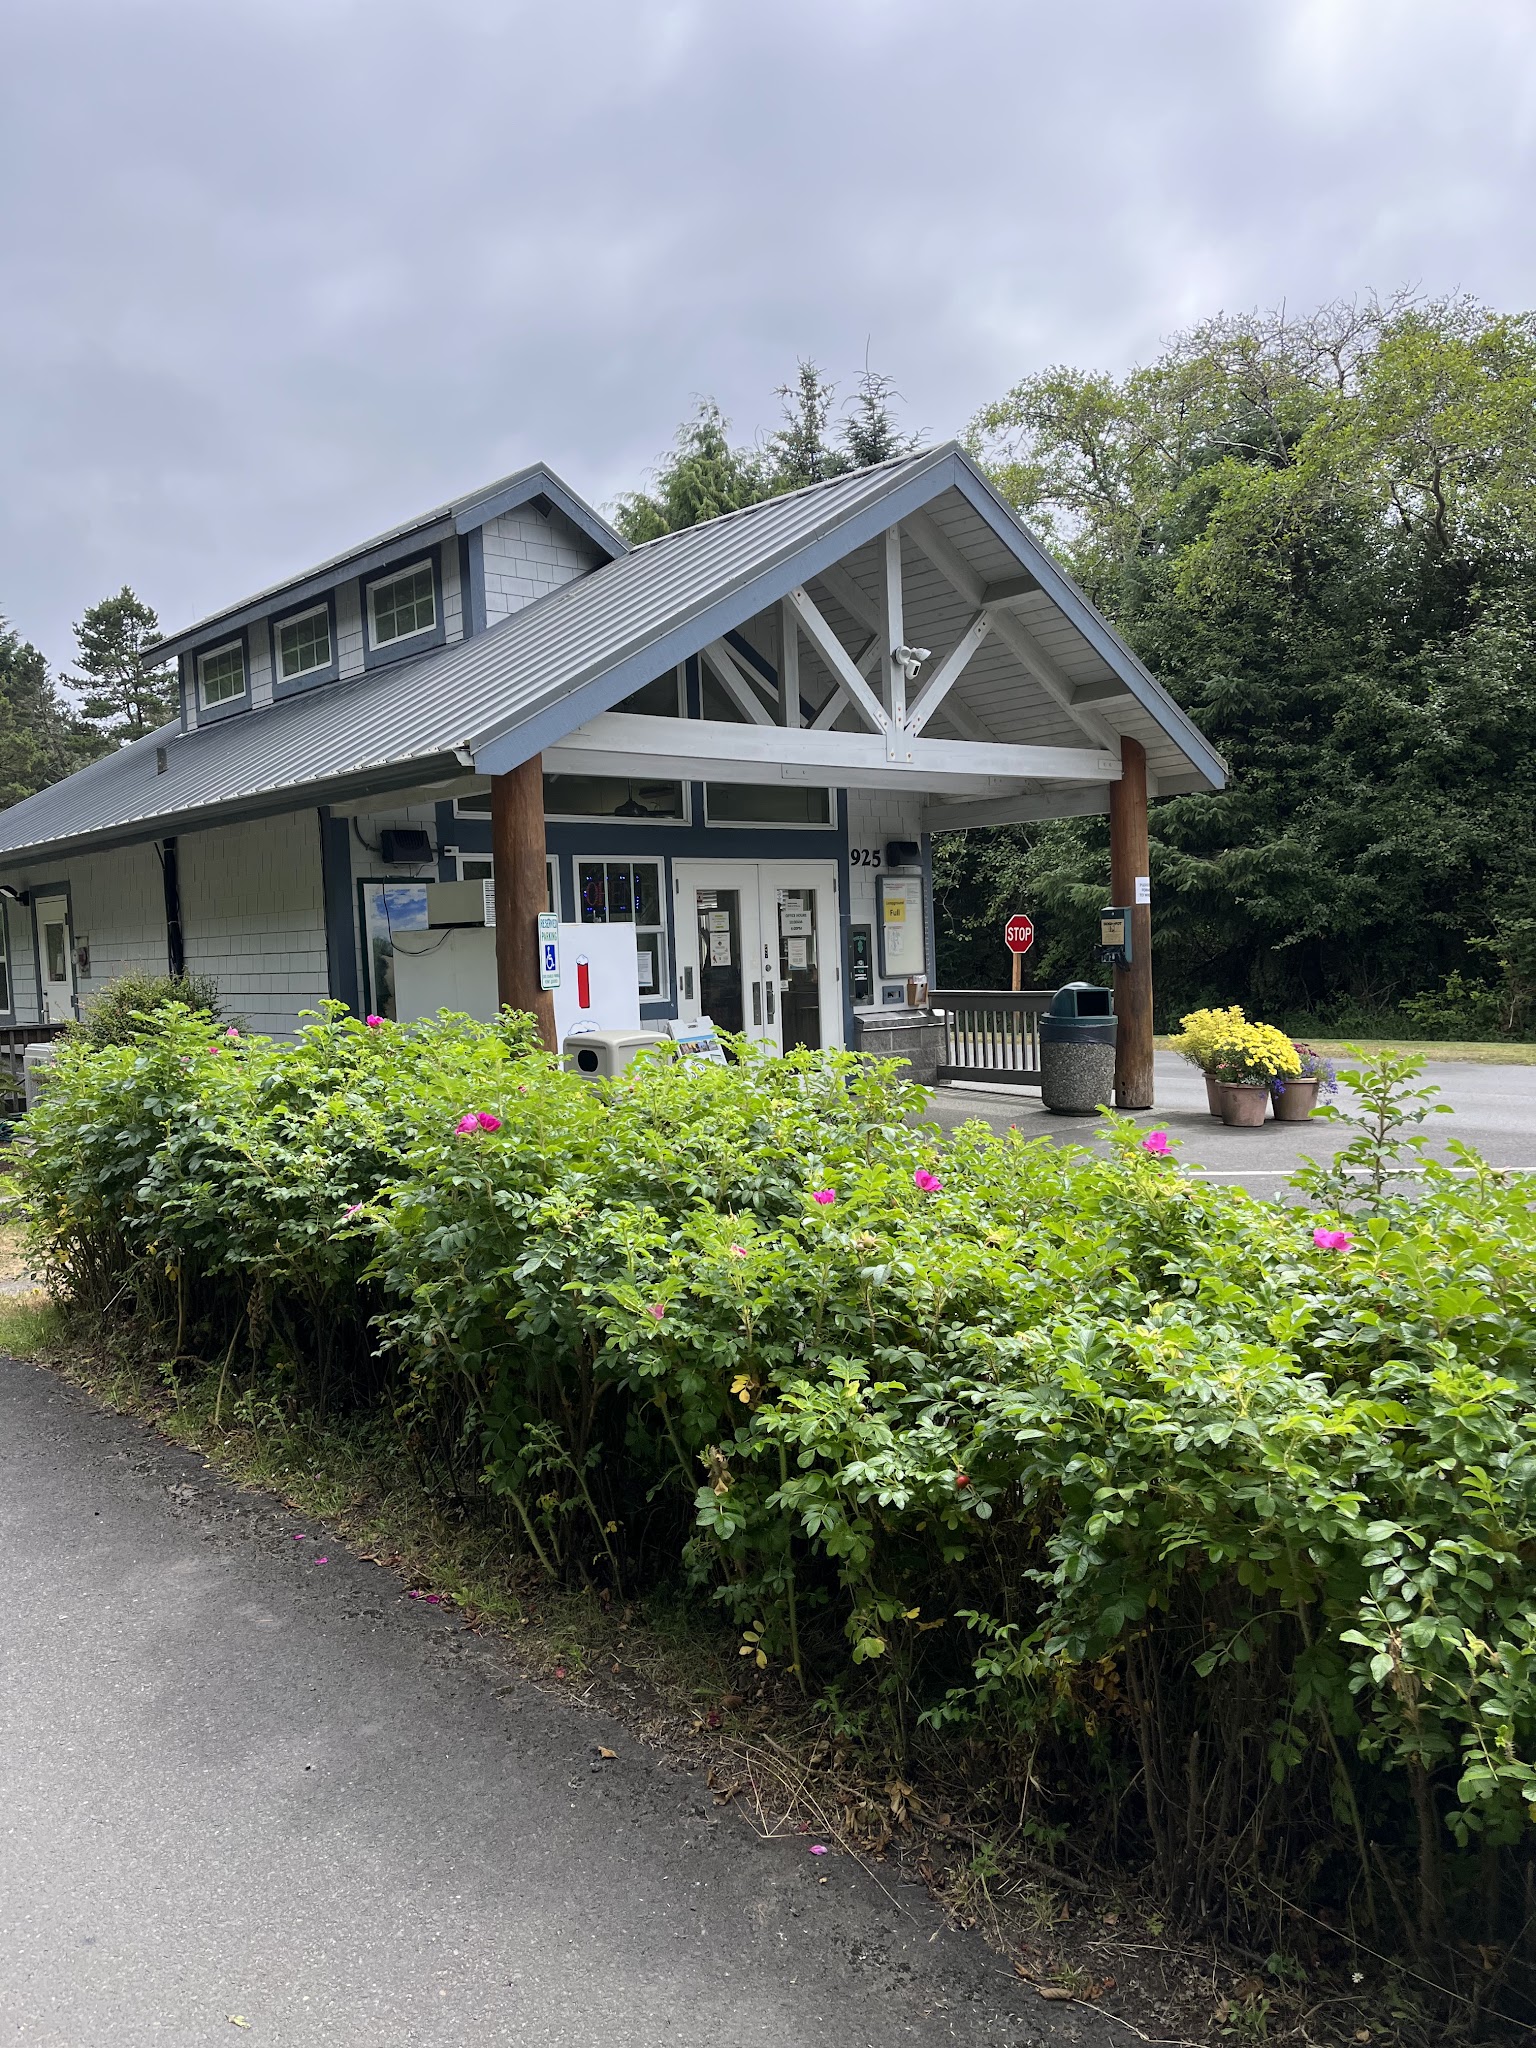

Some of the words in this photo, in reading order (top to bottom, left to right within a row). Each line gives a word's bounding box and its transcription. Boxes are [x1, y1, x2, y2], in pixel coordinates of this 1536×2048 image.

[850, 848, 881, 868] 925
[889, 909, 901, 917] Full
[540, 918, 557, 929] RESERVED
[541, 931, 557, 941] PARKING
[1007, 926, 1032, 942] STOP
